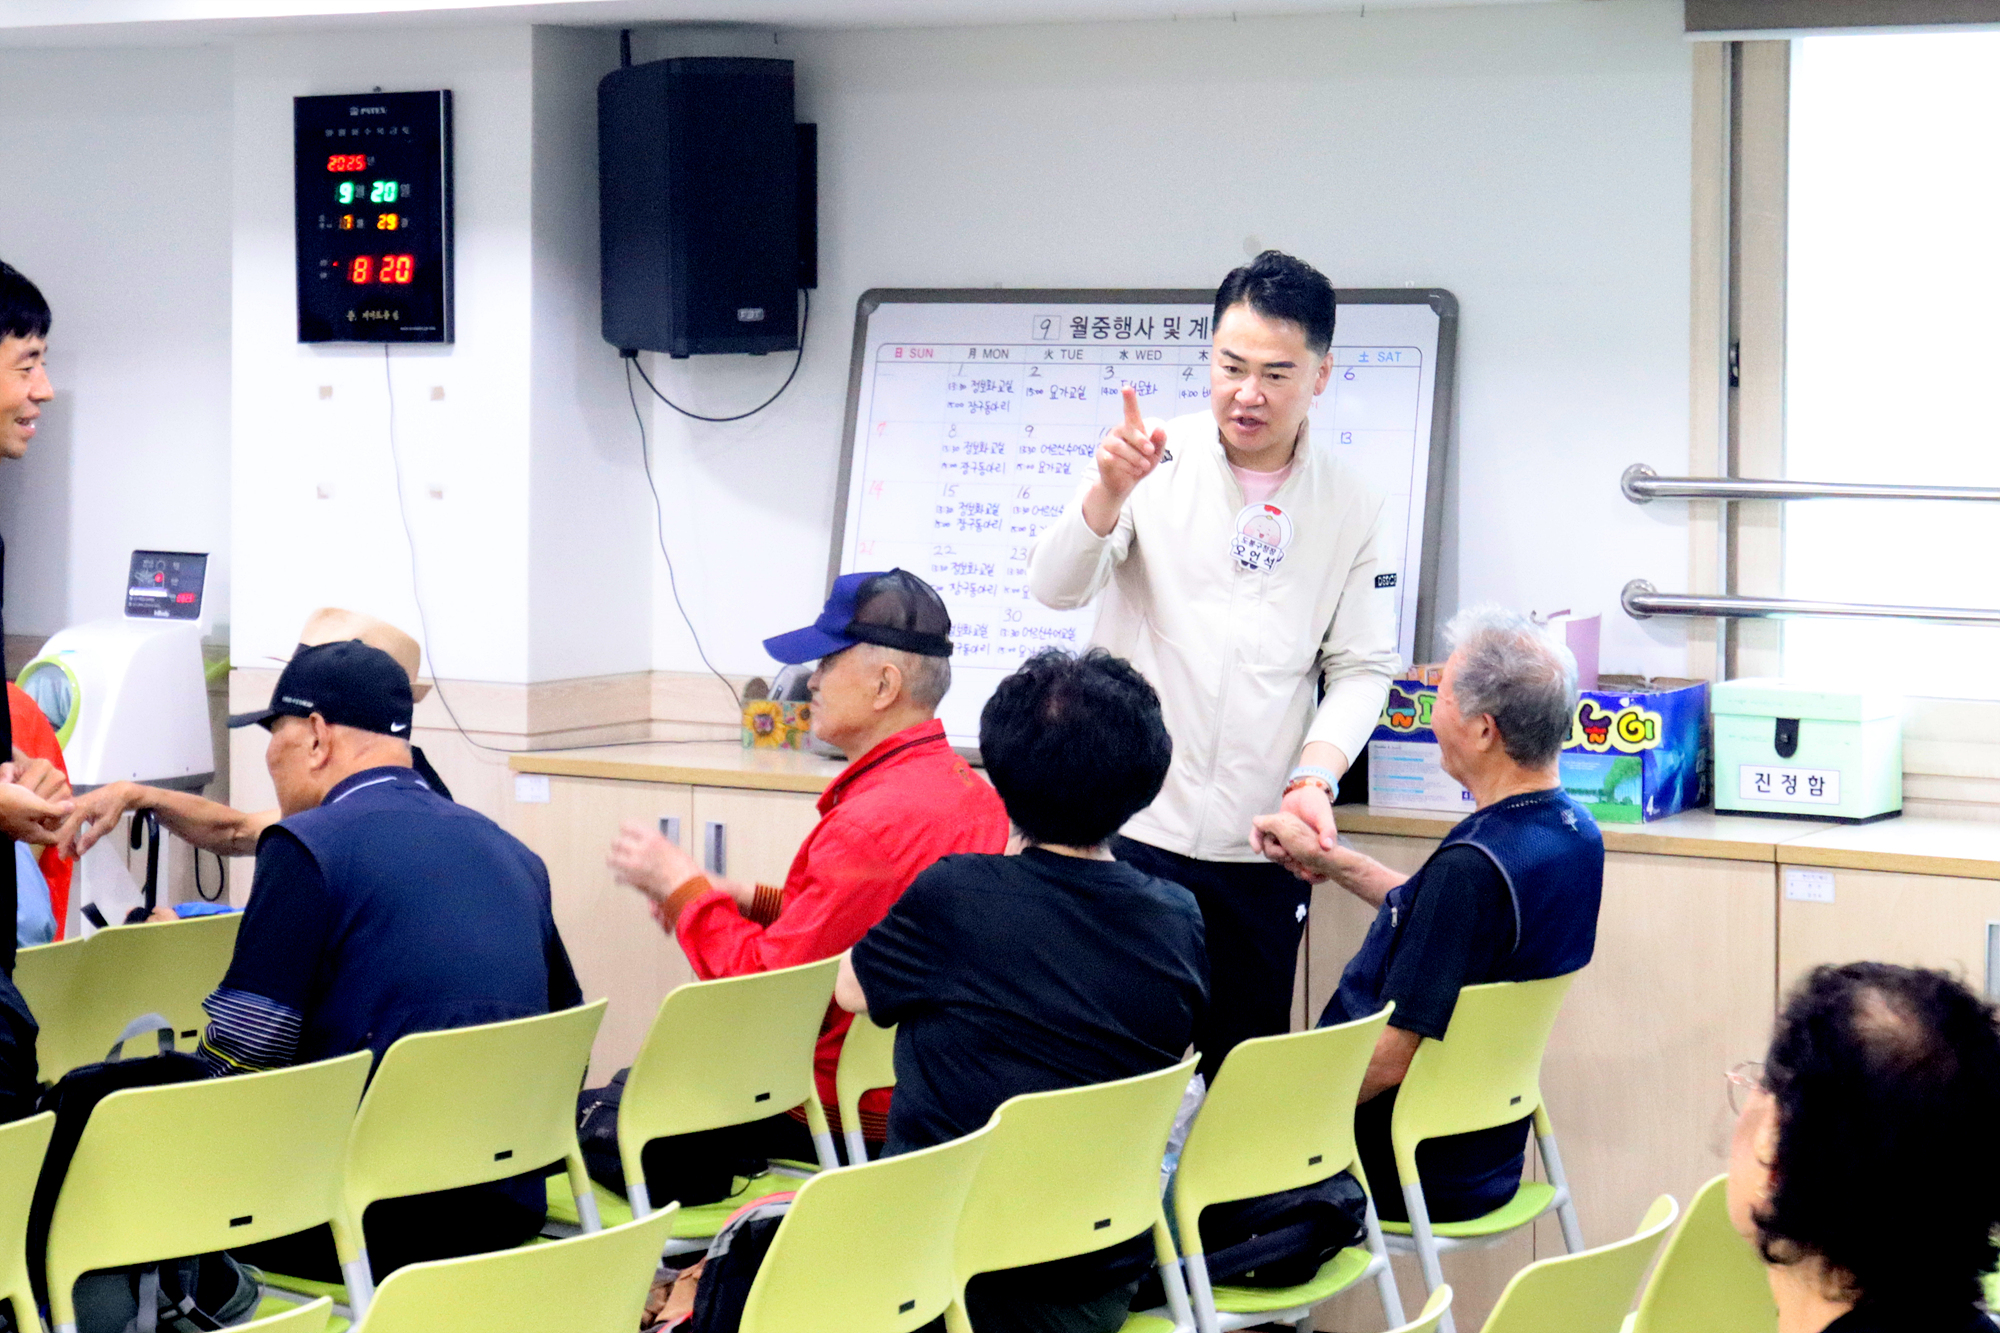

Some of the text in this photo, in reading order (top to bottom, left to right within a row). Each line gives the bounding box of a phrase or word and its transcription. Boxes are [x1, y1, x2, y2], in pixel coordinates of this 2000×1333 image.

[327, 154, 367, 172] 2025
[338, 181, 355, 204] 9
[370, 180, 399, 203] 20
[376, 213, 399, 231] 29
[351, 255, 373, 285] 8
[379, 254, 415, 284] 20
[1039, 315, 1214, 340] 9 월중행사 및 계
[894, 347, 934, 359] 日 SUN
[968, 347, 1009, 359] 月 MON
[1044, 350, 1084, 360] 火 TUE
[1119, 350, 1163, 361] 水 WED
[1199, 350, 1209, 361] 木
[1358, 352, 1402, 363] 土 SAT
[957, 363, 964, 376] 1
[1030, 366, 1041, 377] 2
[1104, 366, 1115, 380] 3
[1182, 367, 1194, 381] 4
[1344, 367, 1356, 380] 6
[1049, 384, 1087, 400] 요가교실
[968, 400, 1010, 415] 장구동아리
[948, 423, 957, 438] 8
[1025, 425, 1034, 438] 9
[1340, 431, 1352, 445] 13
[960, 461, 1006, 476] 장구동아리
[1038, 461, 1072, 475] 요가교실
[943, 483, 959, 497] 15
[1017, 486, 1031, 499] 16
[958, 502, 1000, 517] 정보화교실
[956, 518, 1003, 533] 장구동아리
[933, 545, 957, 555] 22
[1010, 547, 1028, 560] 23
[951, 562, 995, 577] 정보화교실
[949, 581, 997, 597] 장구동아리
[1003, 608, 1022, 622] 30
[1022, 626, 1077, 641] 어르신수어교실
[952, 643, 990, 656] 구동아리
[1754, 772, 1826, 797] 진정함
